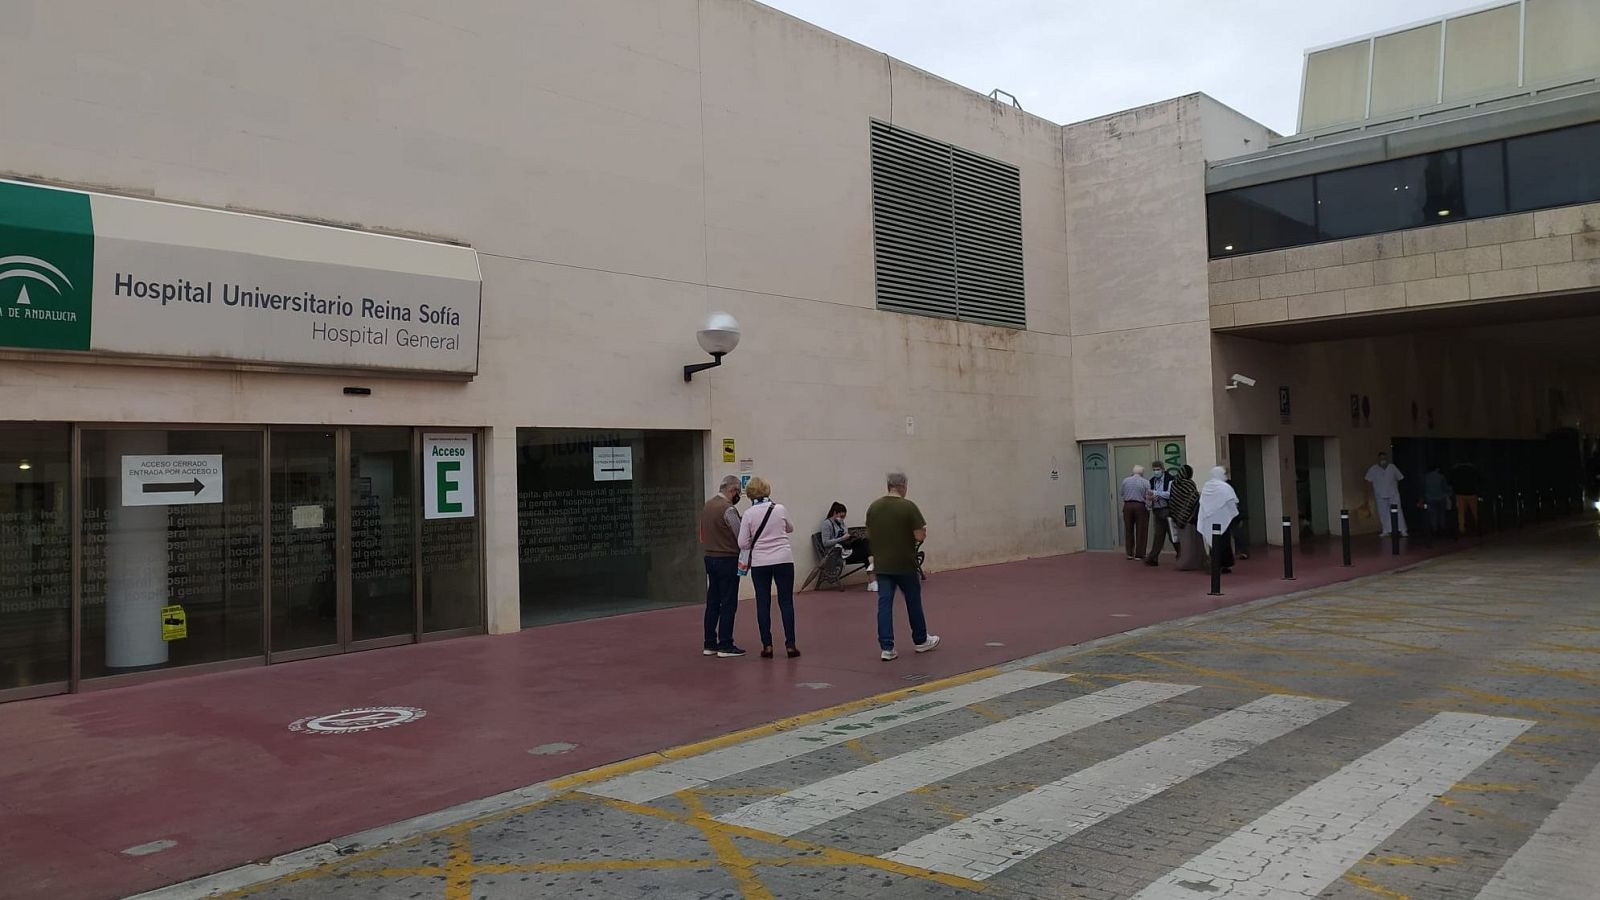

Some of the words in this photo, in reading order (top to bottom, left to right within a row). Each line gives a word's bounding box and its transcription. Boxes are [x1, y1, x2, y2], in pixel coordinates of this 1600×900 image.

[114, 272, 212, 306] Hospital
[222, 283, 354, 318] Universitario
[361, 297, 412, 322] Reina
[419, 304, 461, 327] Sofía
[8, 307, 20, 318] DE
[312, 322, 389, 347] Hospital
[396, 329, 460, 351] General
[432, 445, 465, 457] Acceso
[141, 460, 171, 468] ACCESO
[129, 468, 164, 476] ENTRADA
[181, 467, 212, 475] ACCESO
[436, 461, 463, 513] E
